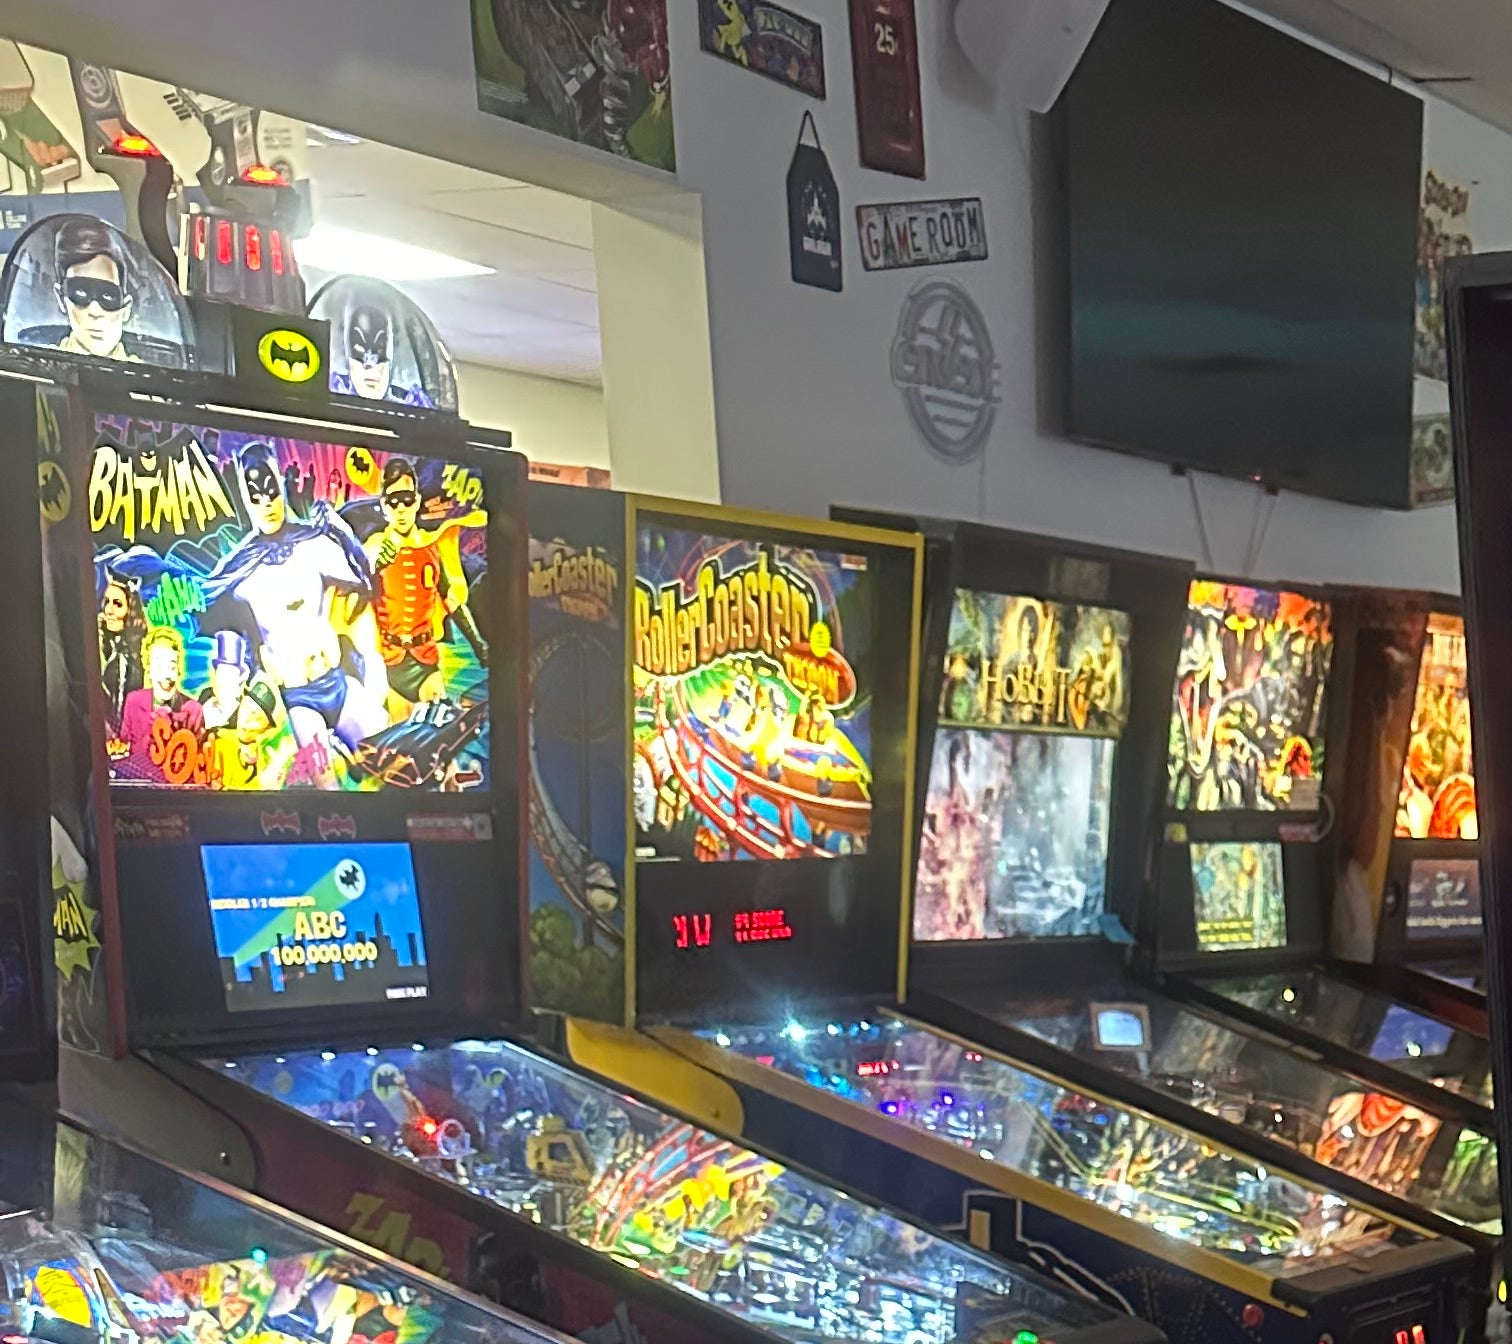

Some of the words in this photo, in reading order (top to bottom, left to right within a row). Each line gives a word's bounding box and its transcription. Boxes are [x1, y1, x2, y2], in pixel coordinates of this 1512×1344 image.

[866, 215, 922, 261] GAME
[927, 206, 978, 255] ROOM
[88, 440, 235, 543] BATMAN
[635, 552, 809, 676] RollerCoaster
[294, 911, 348, 941] ABC
[269, 942, 378, 966] 100.000.000
